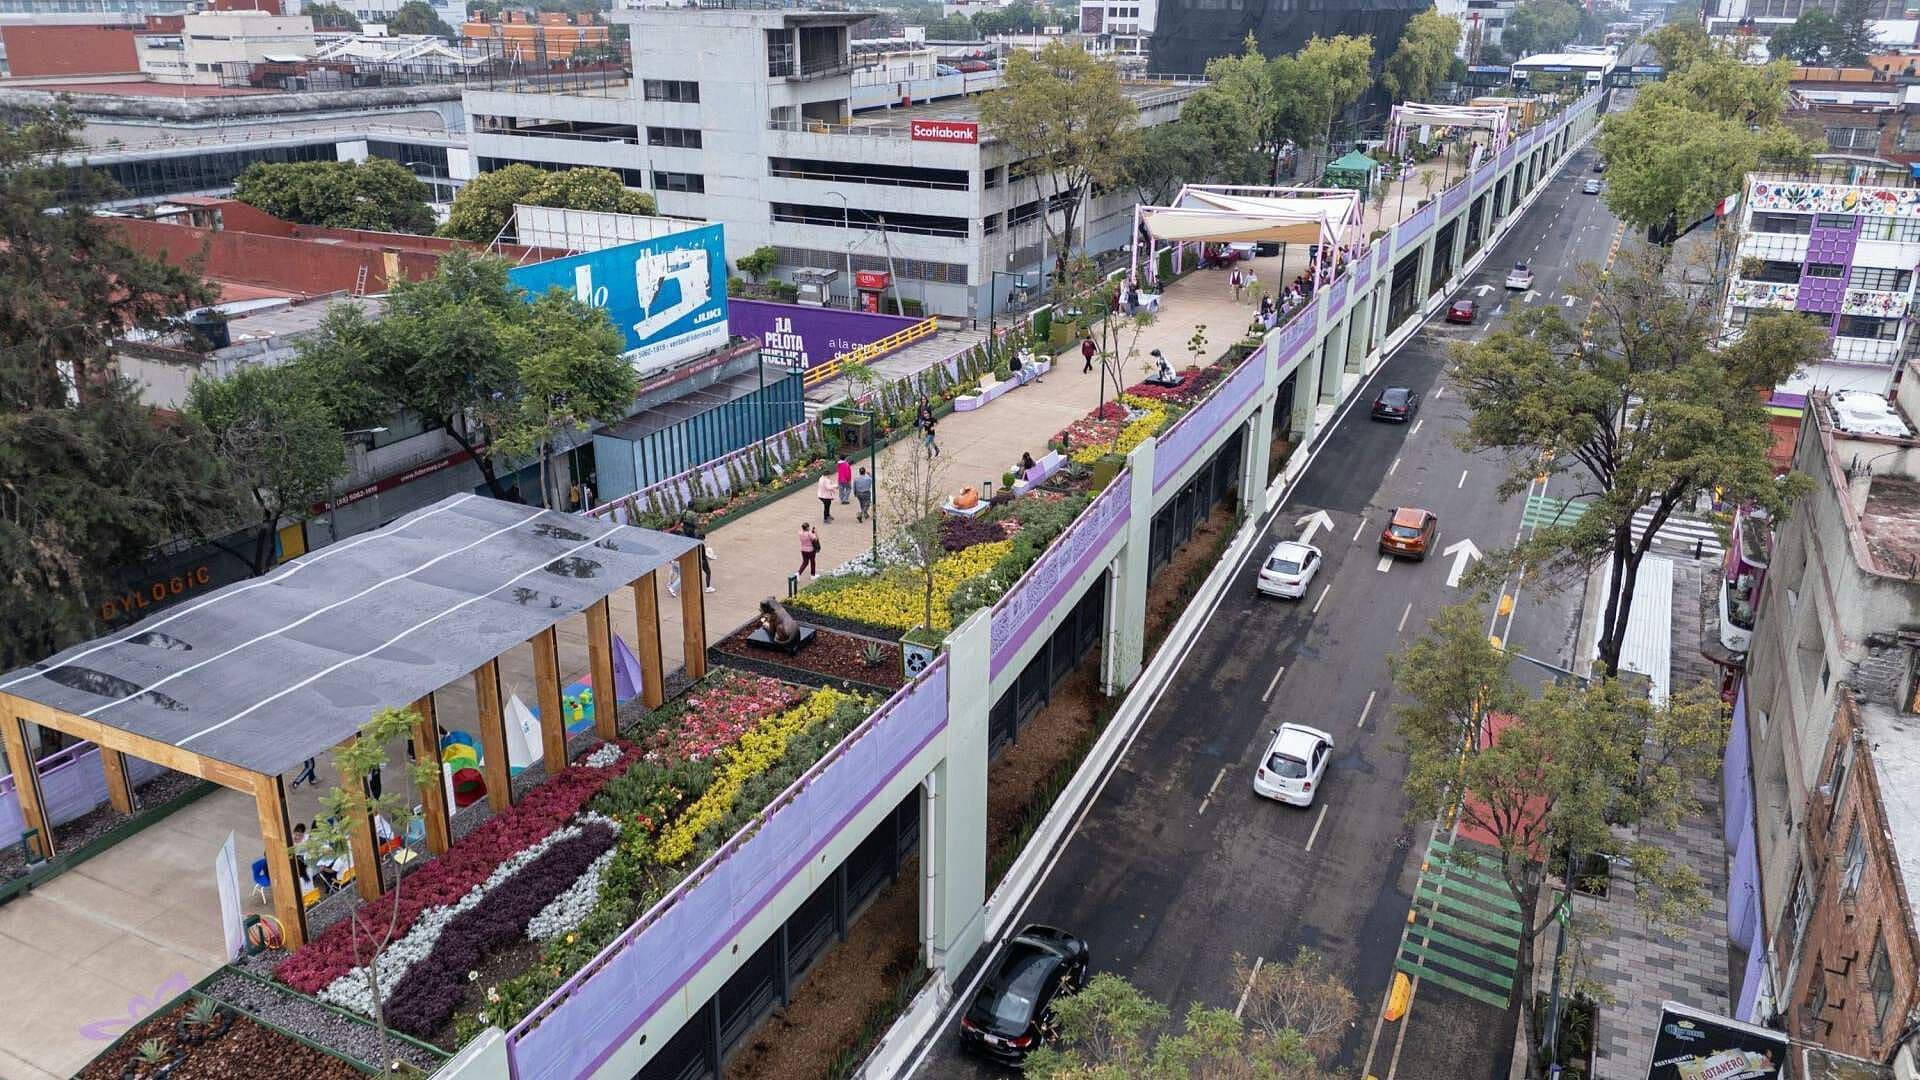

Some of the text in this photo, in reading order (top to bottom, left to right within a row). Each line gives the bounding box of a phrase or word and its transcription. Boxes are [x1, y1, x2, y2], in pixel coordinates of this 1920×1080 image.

[914, 125, 973, 139] Scotiabank
[693, 307, 721, 324] JUKI
[765, 332, 803, 351] PELOTA
[828, 339, 836, 348] a
[838, 338, 849, 349] la
[800, 352, 809, 369] A
[1702, 1056, 1745, 1080] BOTANERO
